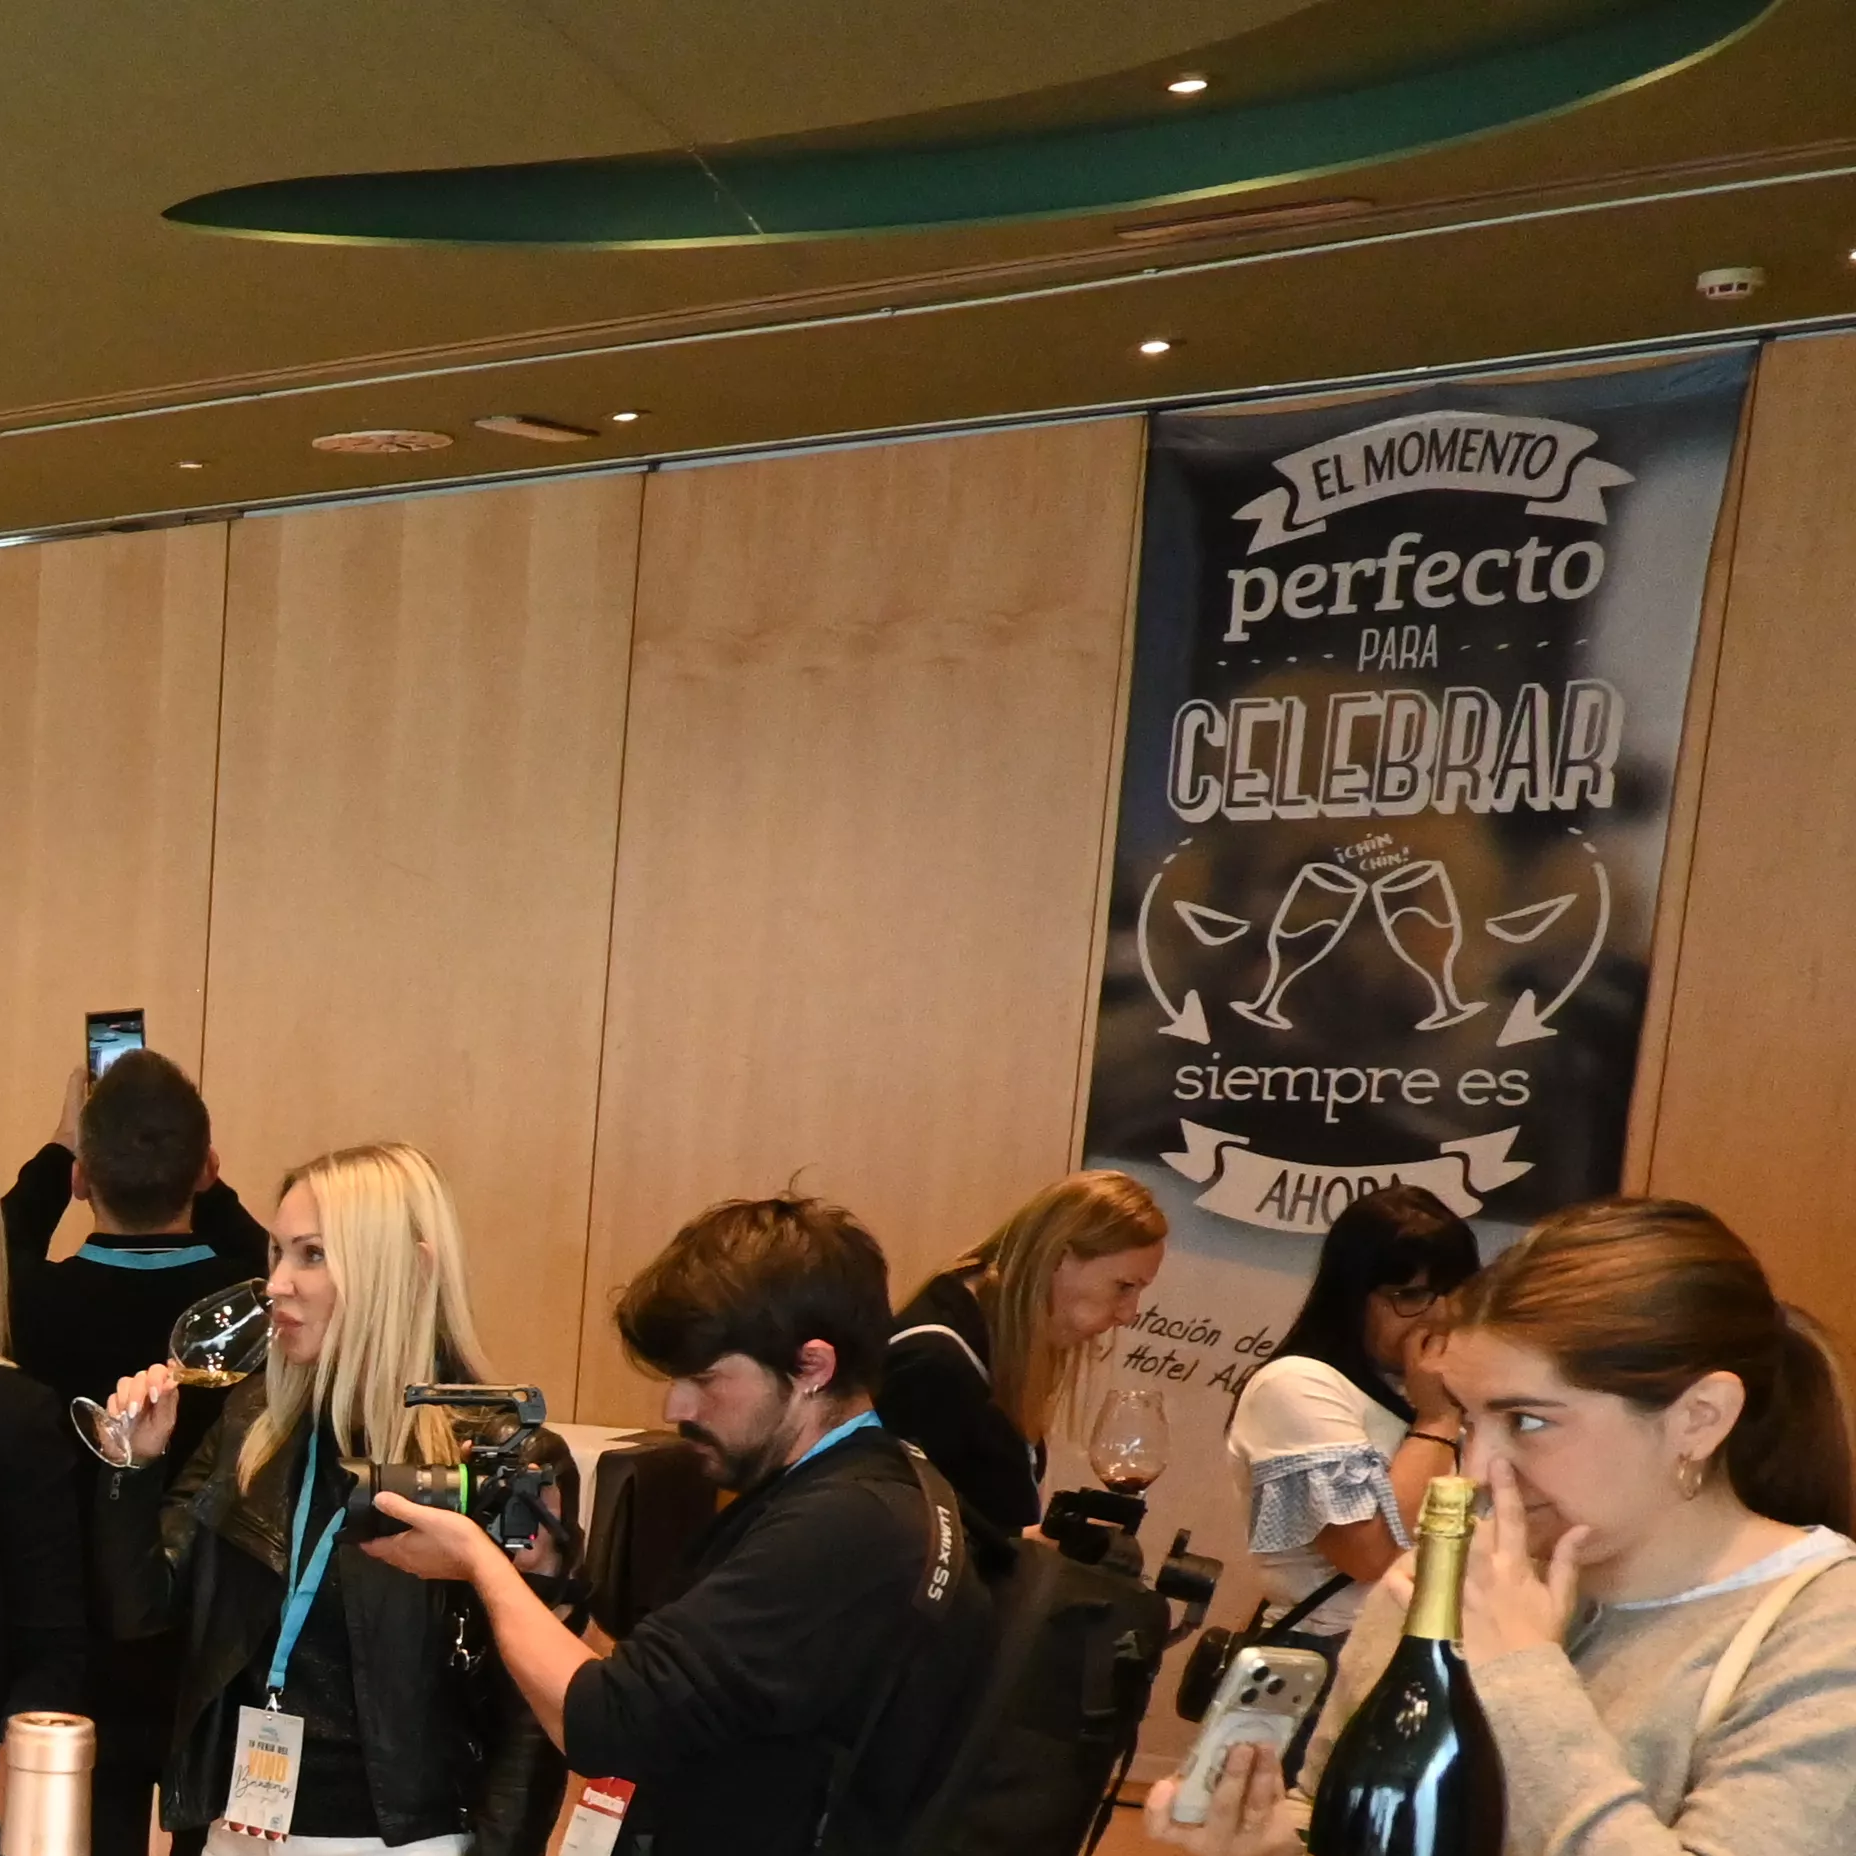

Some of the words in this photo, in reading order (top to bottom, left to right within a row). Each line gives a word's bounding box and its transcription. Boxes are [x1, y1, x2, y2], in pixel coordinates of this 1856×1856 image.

[1311, 453, 1355, 502] EL
[1363, 427, 1559, 487] MOMENTO
[1222, 531, 1605, 643] perfecto
[1356, 624, 1439, 673] PARA
[1166, 678, 1625, 823] CELEBRAR
[1173, 1052, 1441, 1124] siempre
[1456, 1067, 1532, 1106] es
[1255, 1169, 1404, 1227] AHO
[1123, 1345, 1202, 1383] Hotel
[935, 1504, 953, 1566] LUMIX
